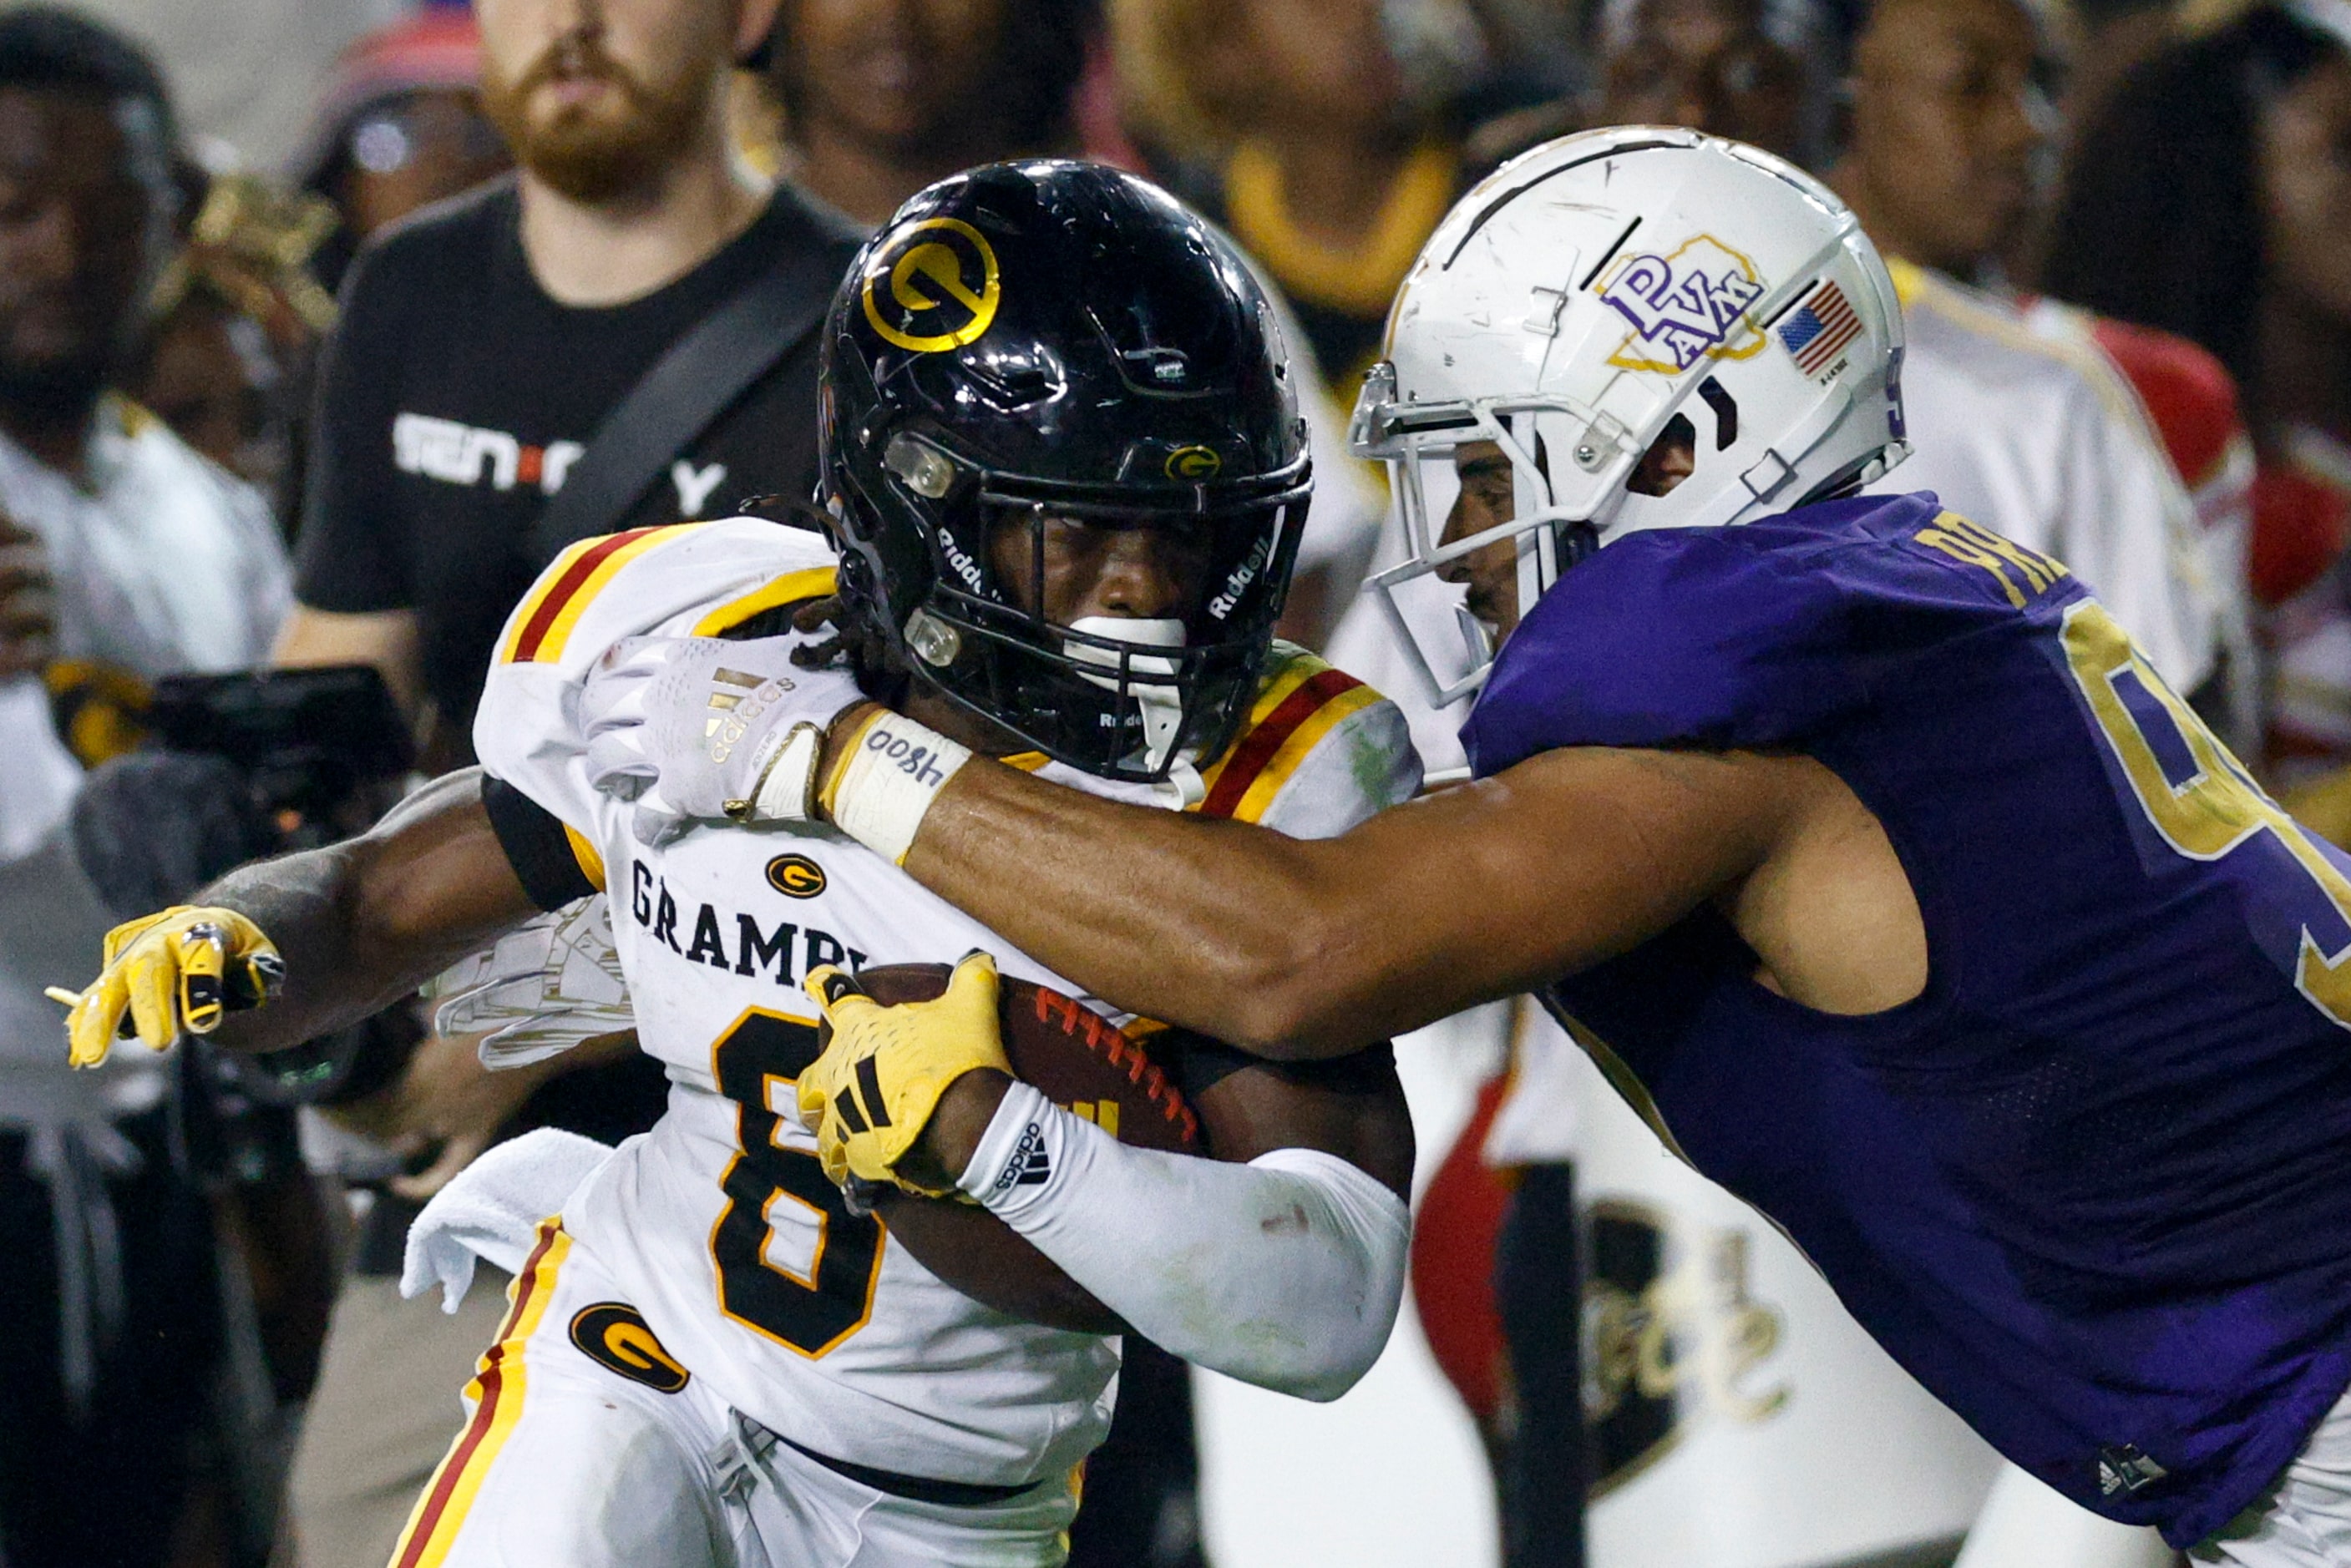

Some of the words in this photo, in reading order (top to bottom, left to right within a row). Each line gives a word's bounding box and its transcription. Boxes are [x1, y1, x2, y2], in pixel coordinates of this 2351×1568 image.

[710, 676, 797, 765] adidas
[709, 1004, 887, 1361] 8
[996, 1121, 1041, 1190] adidas
